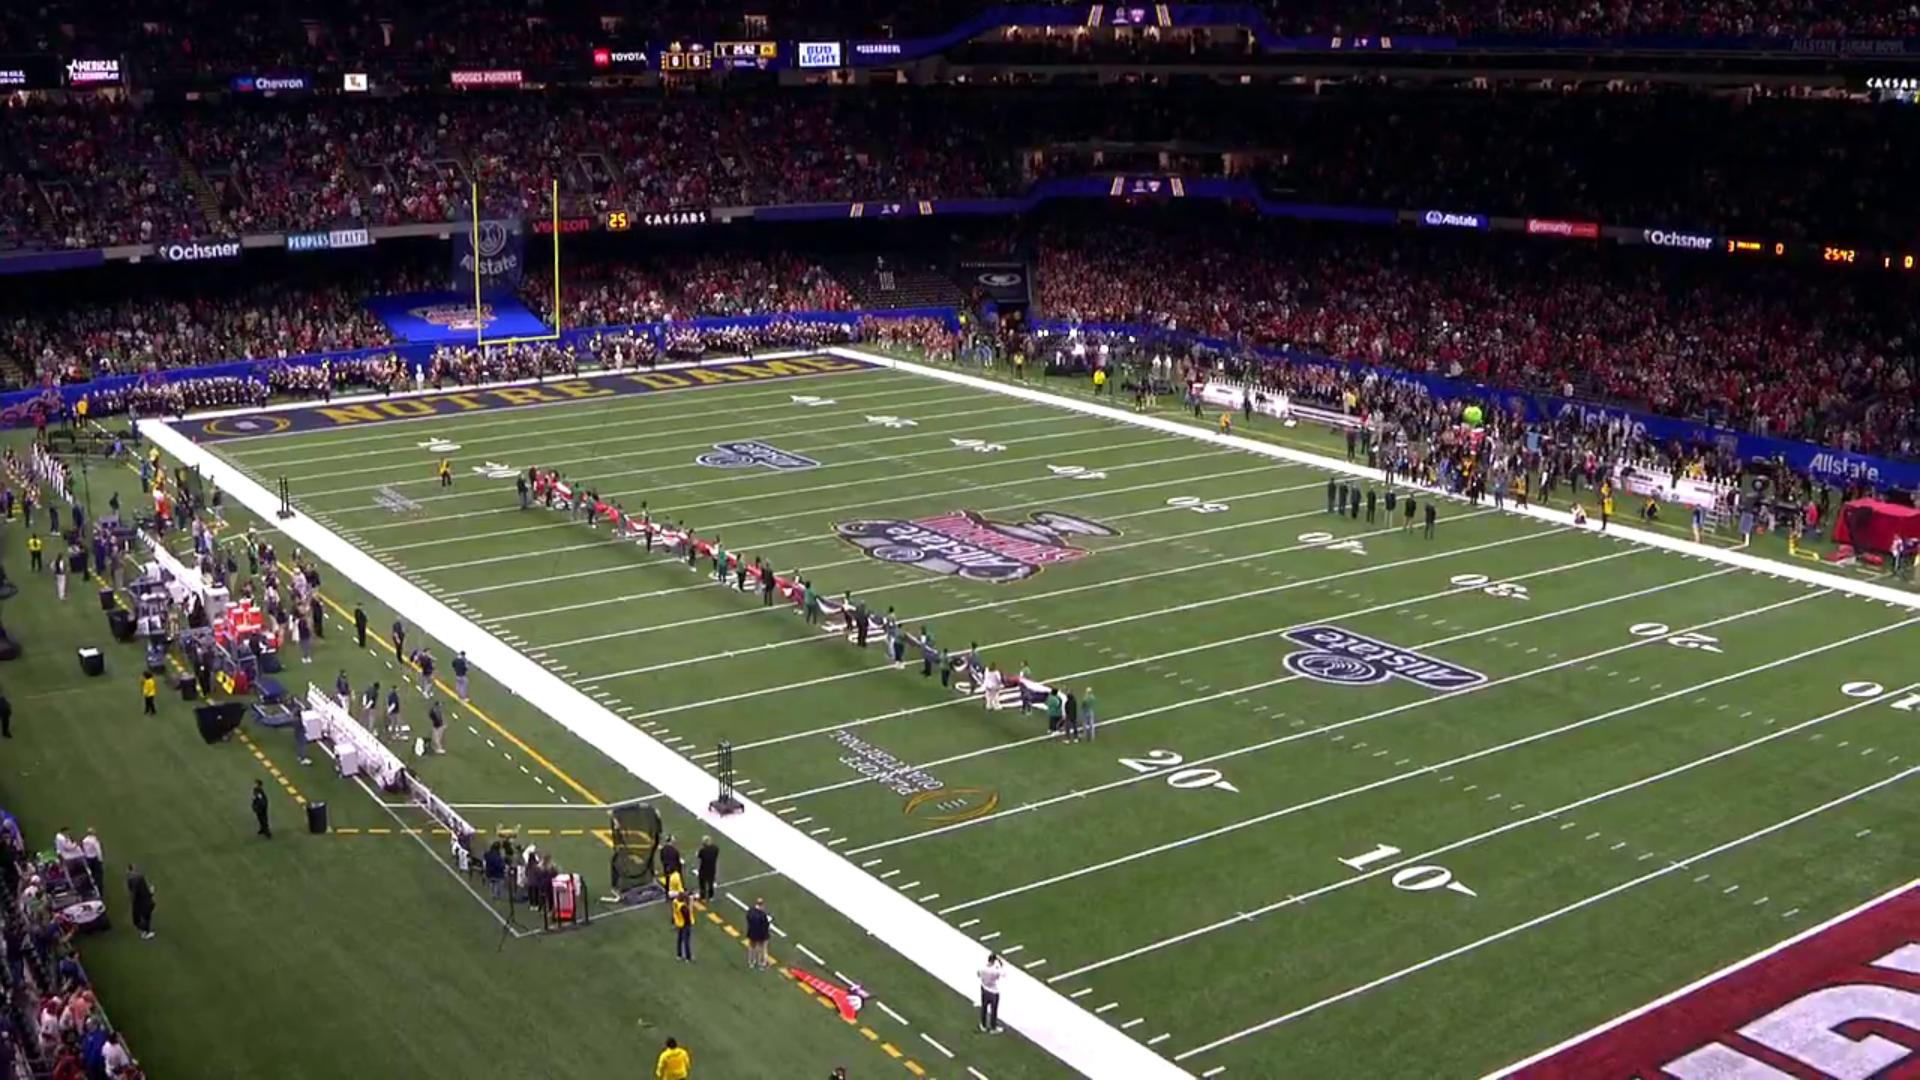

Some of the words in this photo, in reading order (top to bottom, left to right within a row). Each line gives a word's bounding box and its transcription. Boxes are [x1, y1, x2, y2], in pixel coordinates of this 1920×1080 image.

[611, 52, 647, 62] TOYOTA
[801, 55, 836, 64] LIGHT
[255, 77, 304, 90] Chevron
[608, 212, 627, 229] 25
[644, 211, 706, 226] CAESARS
[1650, 230, 1712, 250] Ochsner
[168, 241, 240, 261] Ochsner
[318, 381, 614, 424] NOTRE
[629, 356, 860, 390] DAME
[1809, 452, 1880, 481] Allstate
[1313, 627, 1477, 681] Allstate
